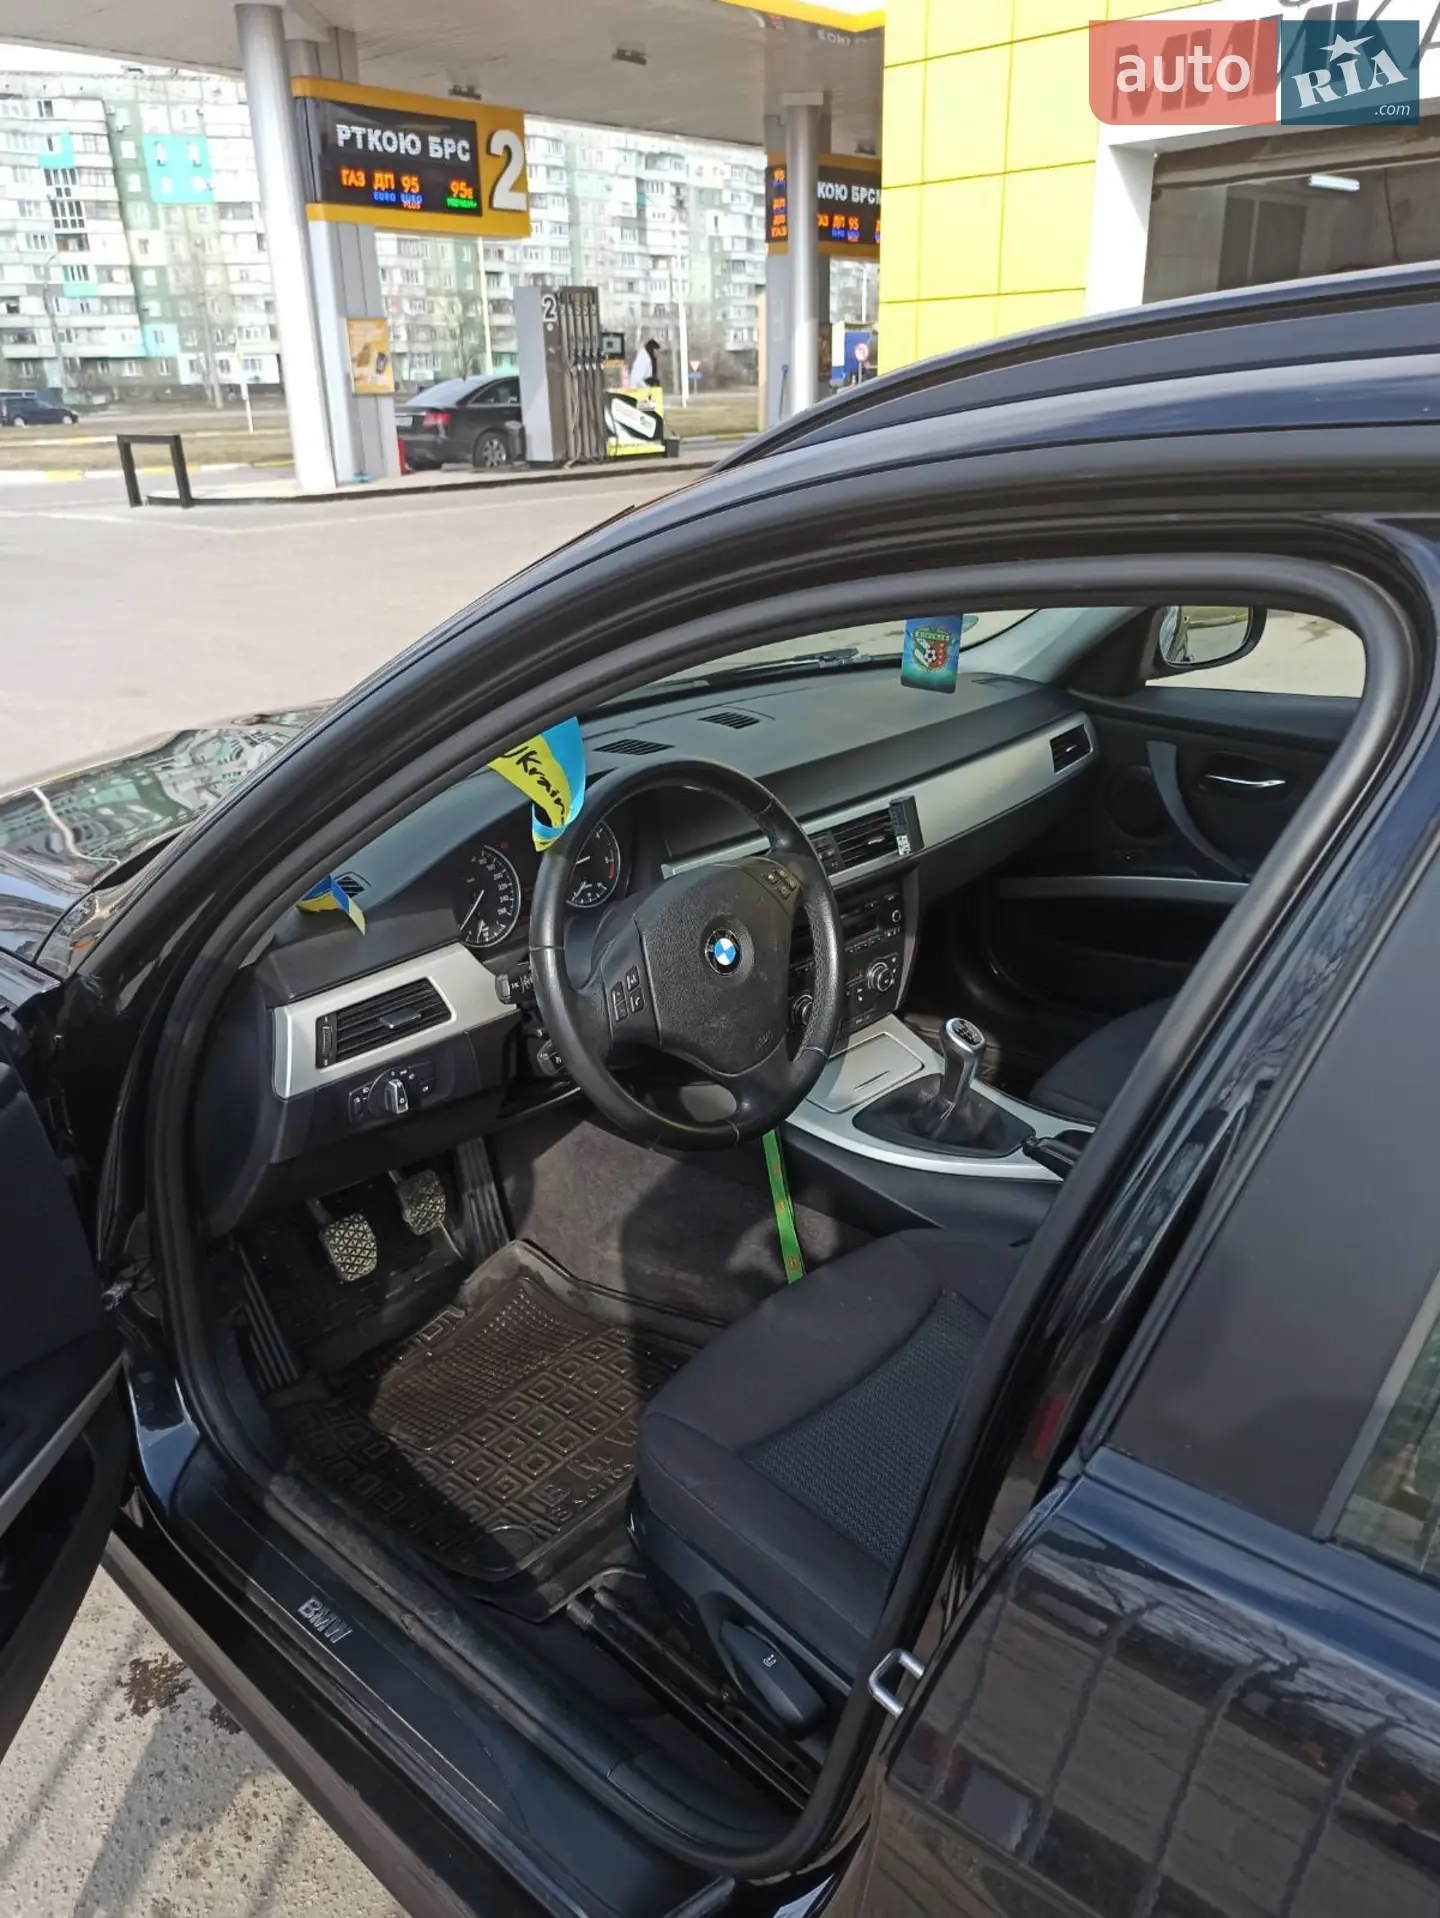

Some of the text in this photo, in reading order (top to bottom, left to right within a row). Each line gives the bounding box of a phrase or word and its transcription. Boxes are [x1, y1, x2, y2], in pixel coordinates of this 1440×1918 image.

[335, 123, 471, 162] РТКОЮ БРС
[340, 168, 367, 188] ГАЗ
[372, 170, 396, 191] ДП
[400, 174, 420, 194] 95
[489, 129, 527, 212] 2
[542, 294, 558, 322] 2
[297, 1596, 353, 1644] BMW
